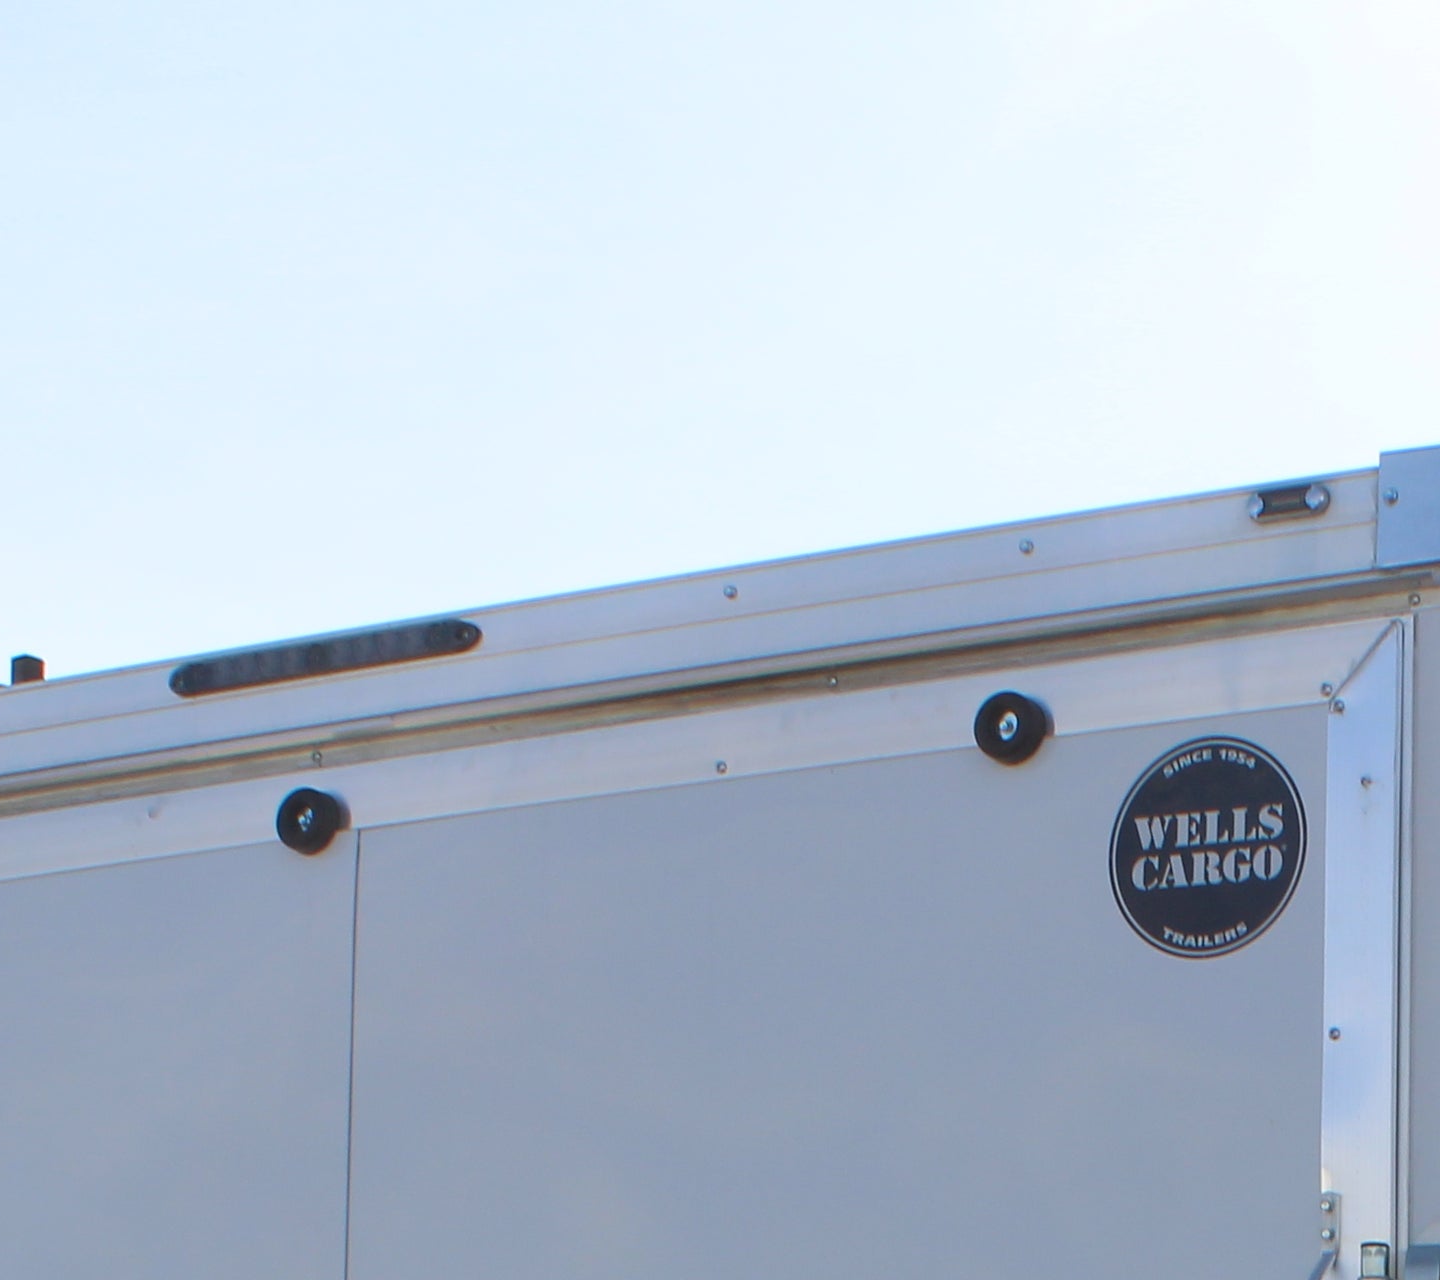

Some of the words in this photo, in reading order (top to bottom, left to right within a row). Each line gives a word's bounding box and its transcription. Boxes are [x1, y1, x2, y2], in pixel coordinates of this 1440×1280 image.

[1163, 749, 1213, 778] SINCE
[1219, 749, 1256, 770] 1954
[1134, 803, 1284, 850] WELLS
[1131, 845, 1283, 891] CARGO
[1163, 921, 1248, 947] TRAILERS
